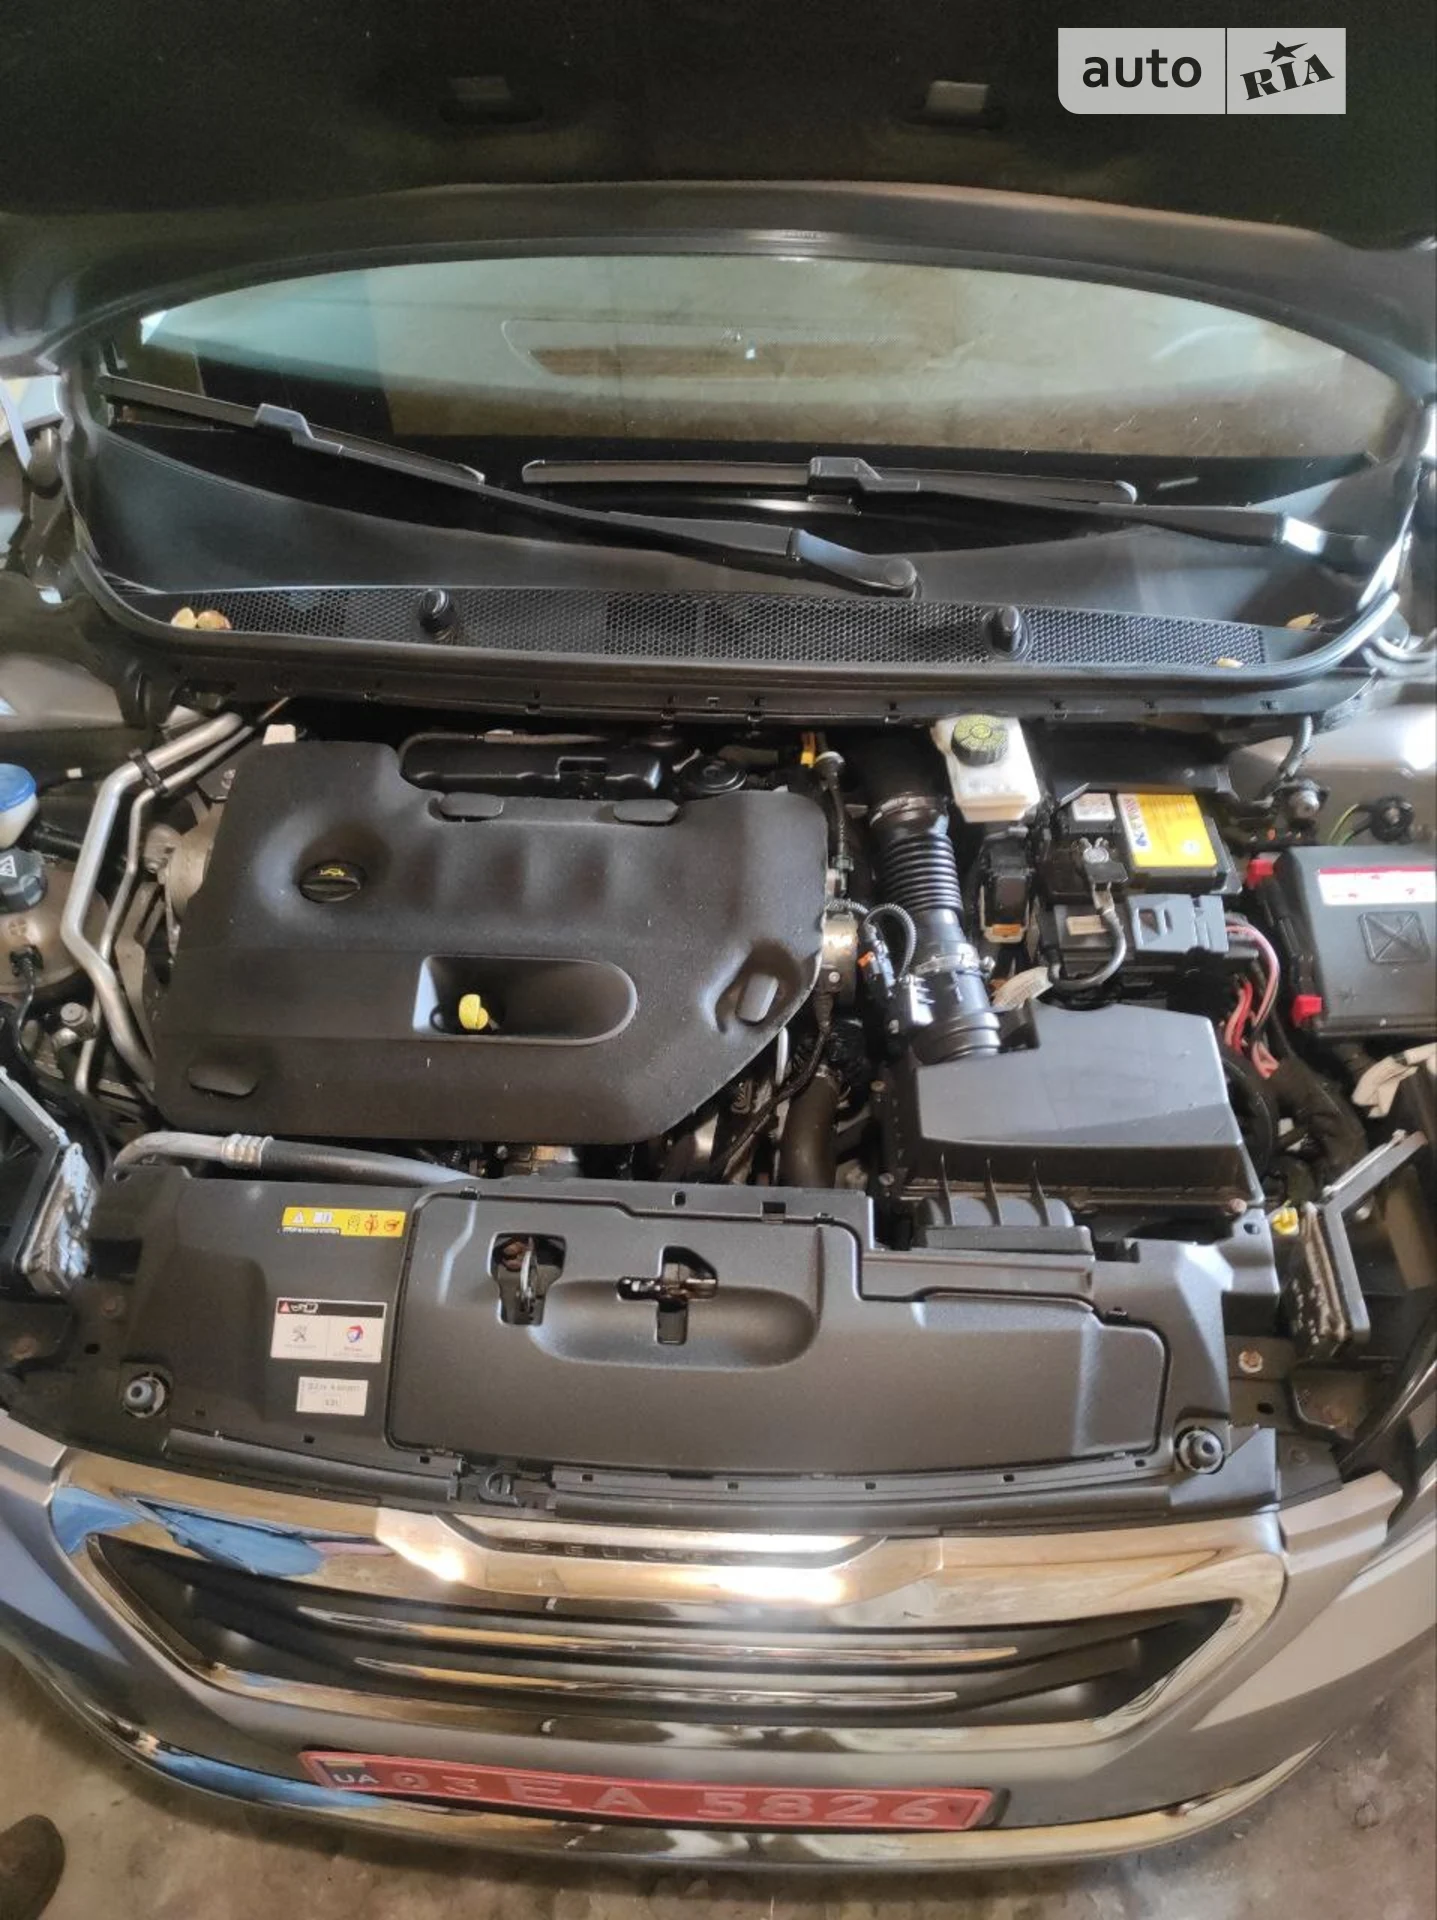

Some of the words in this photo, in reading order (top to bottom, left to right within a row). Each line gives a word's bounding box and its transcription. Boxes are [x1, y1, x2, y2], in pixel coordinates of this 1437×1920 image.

[332, 1772, 380, 1785] UA
[505, 1777, 652, 1814] EA
[697, 1792, 944, 1822] 5826
